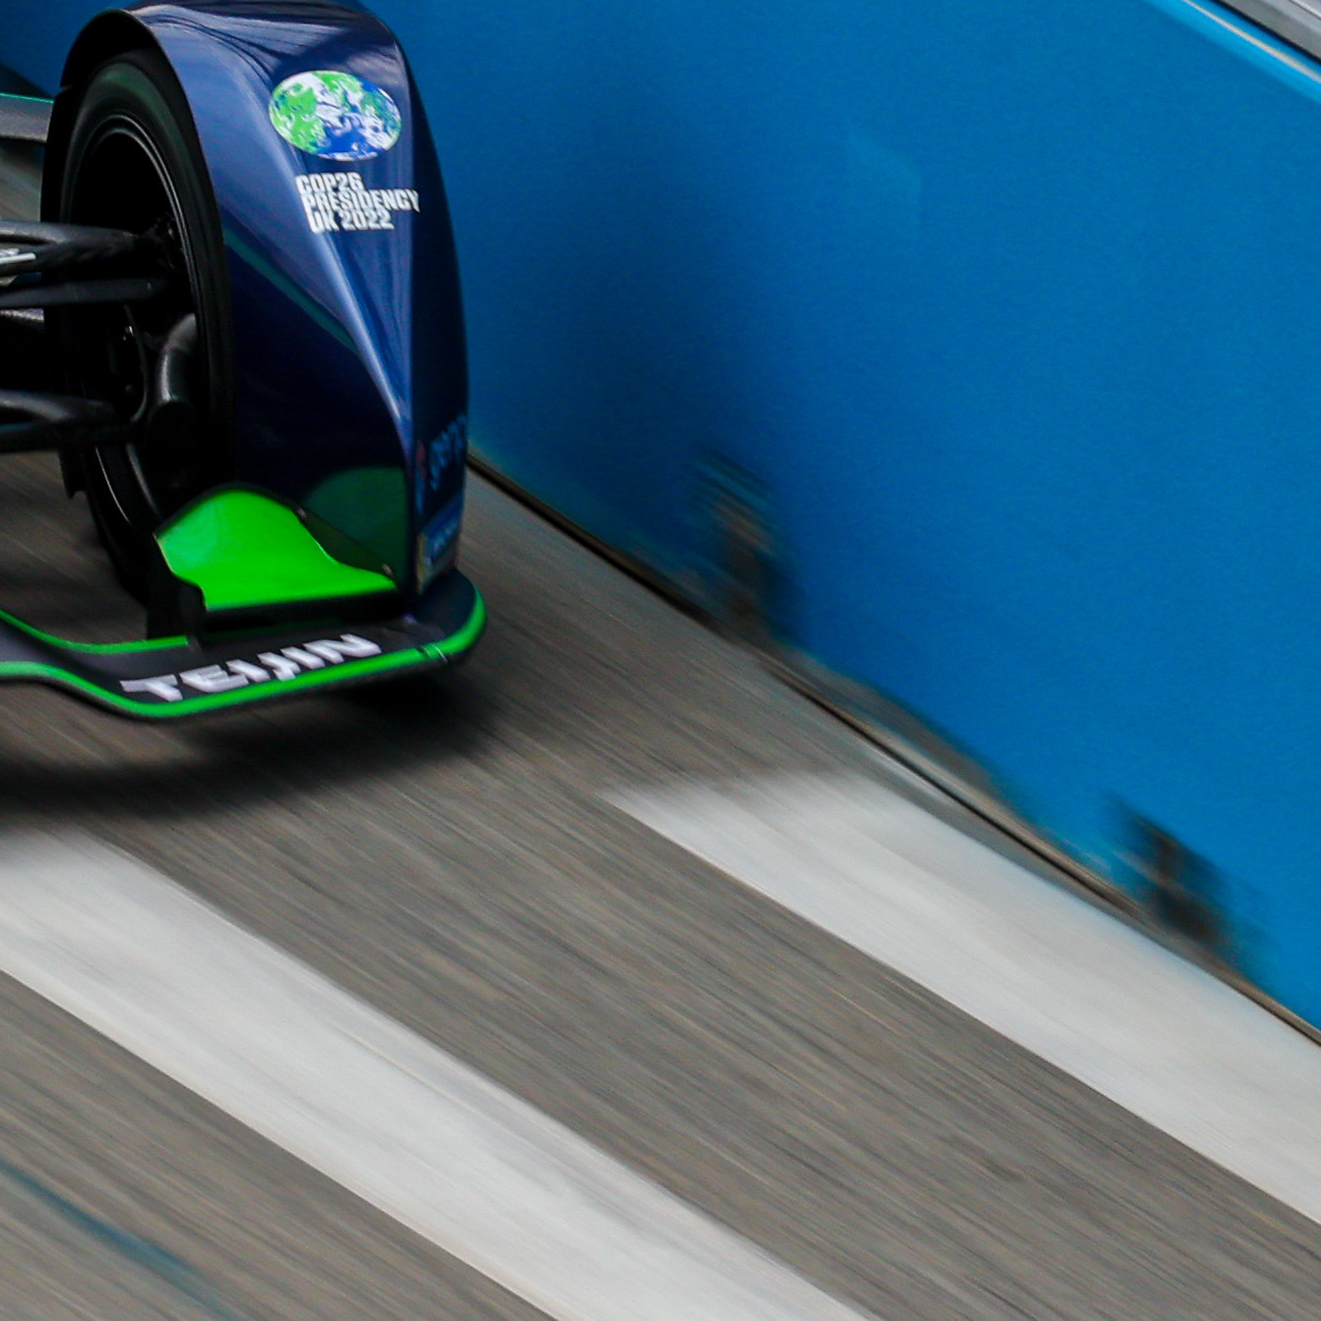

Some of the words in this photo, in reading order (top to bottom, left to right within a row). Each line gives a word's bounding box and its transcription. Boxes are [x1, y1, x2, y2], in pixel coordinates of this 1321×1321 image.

[295, 171, 364, 195] COP26
[300, 188, 421, 213] PRESIDENCY
[337, 207, 395, 231] 2022
[120, 632, 382, 702] TEIJIN
